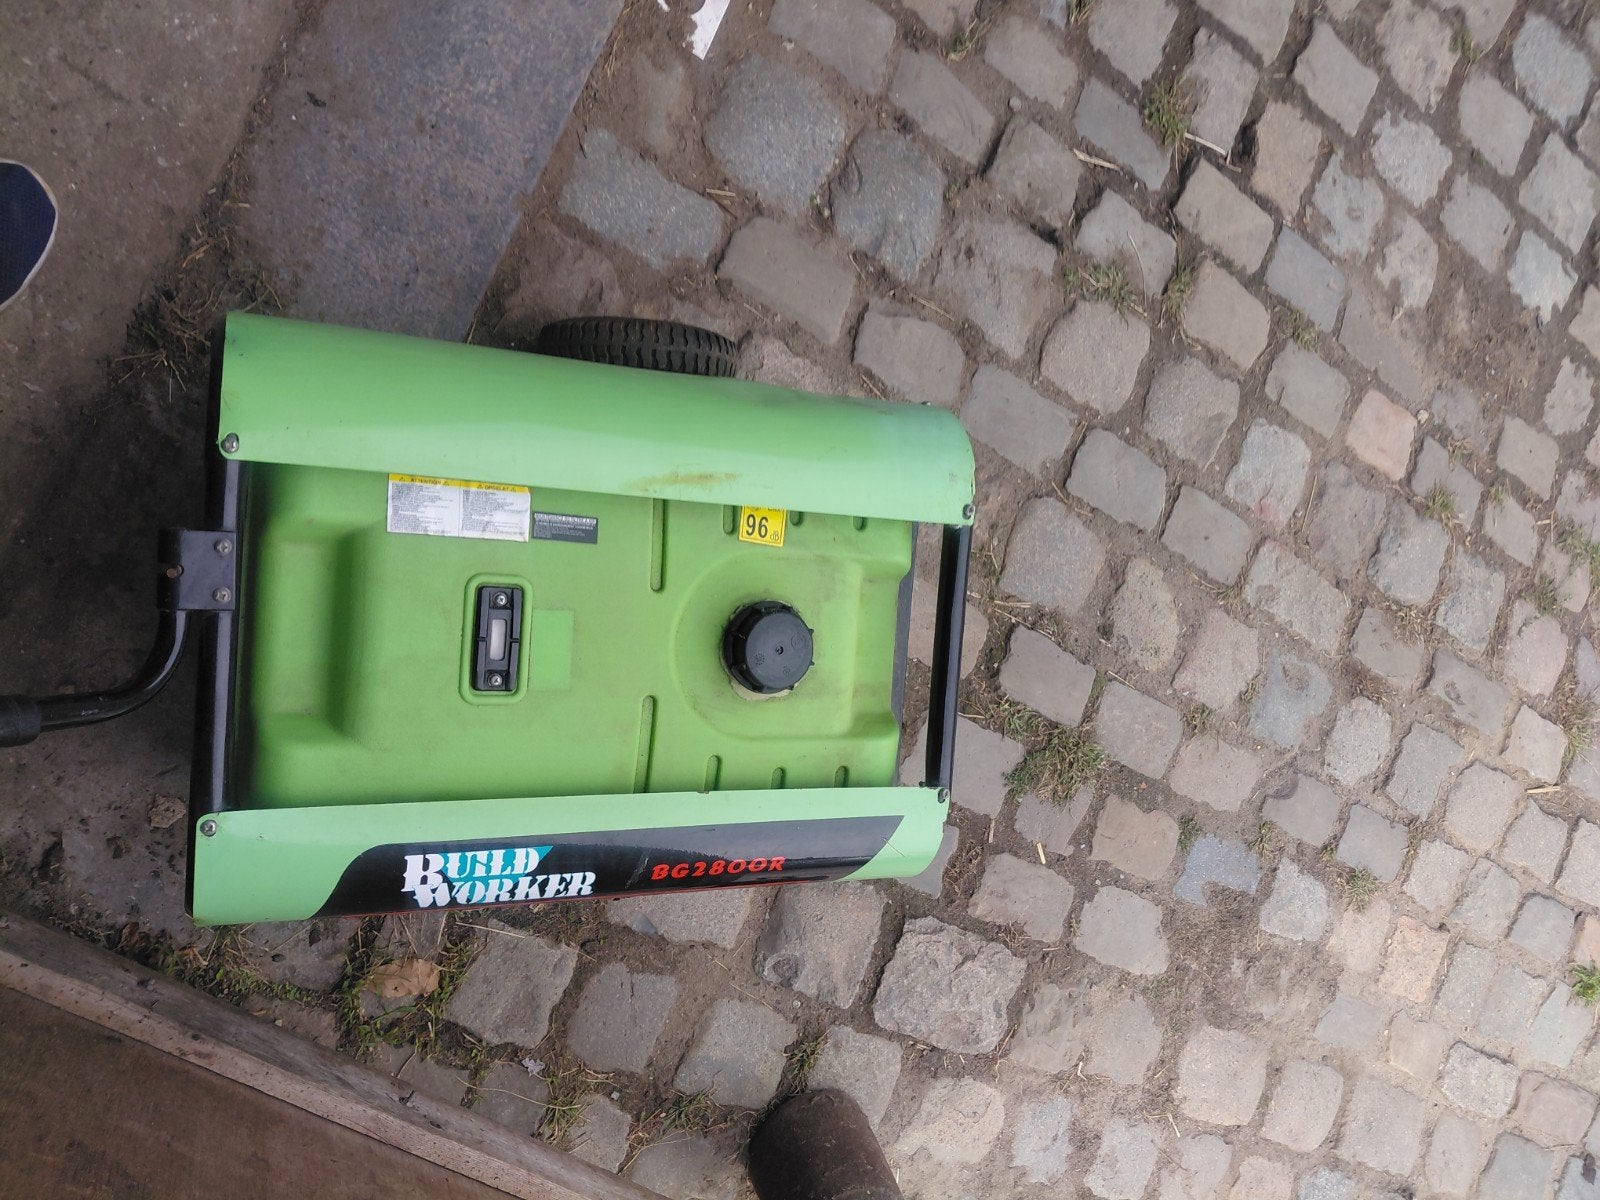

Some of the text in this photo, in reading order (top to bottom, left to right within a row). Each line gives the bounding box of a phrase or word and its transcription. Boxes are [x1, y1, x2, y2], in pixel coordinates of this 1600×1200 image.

[411, 477, 441, 485] ATTENTION
[745, 513, 769, 539] 96
[401, 848, 539, 892] BUILD
[651, 856, 785, 880] BG2800R
[412, 872, 597, 908] WORKER
